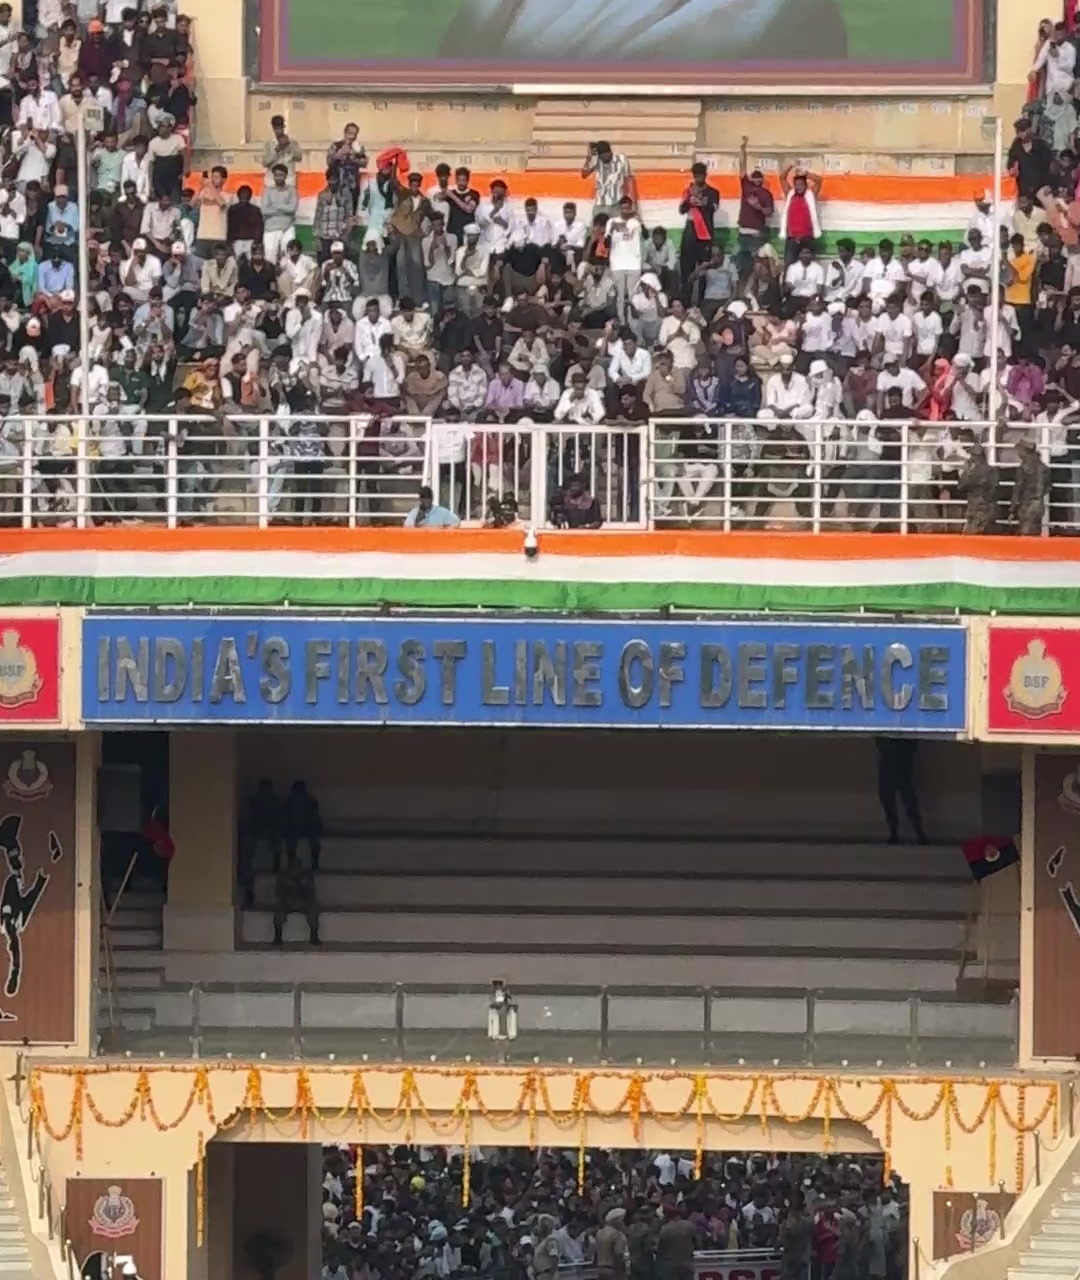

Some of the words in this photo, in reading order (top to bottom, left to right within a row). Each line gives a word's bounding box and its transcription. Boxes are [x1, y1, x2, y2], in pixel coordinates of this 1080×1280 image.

[97, 631, 291, 703] INDIA'S
[306, 638, 467, 704] FIRST
[482, 639, 602, 706] LINE
[620, 639, 687, 708] OF
[700, 641, 950, 710] DEFENCE
